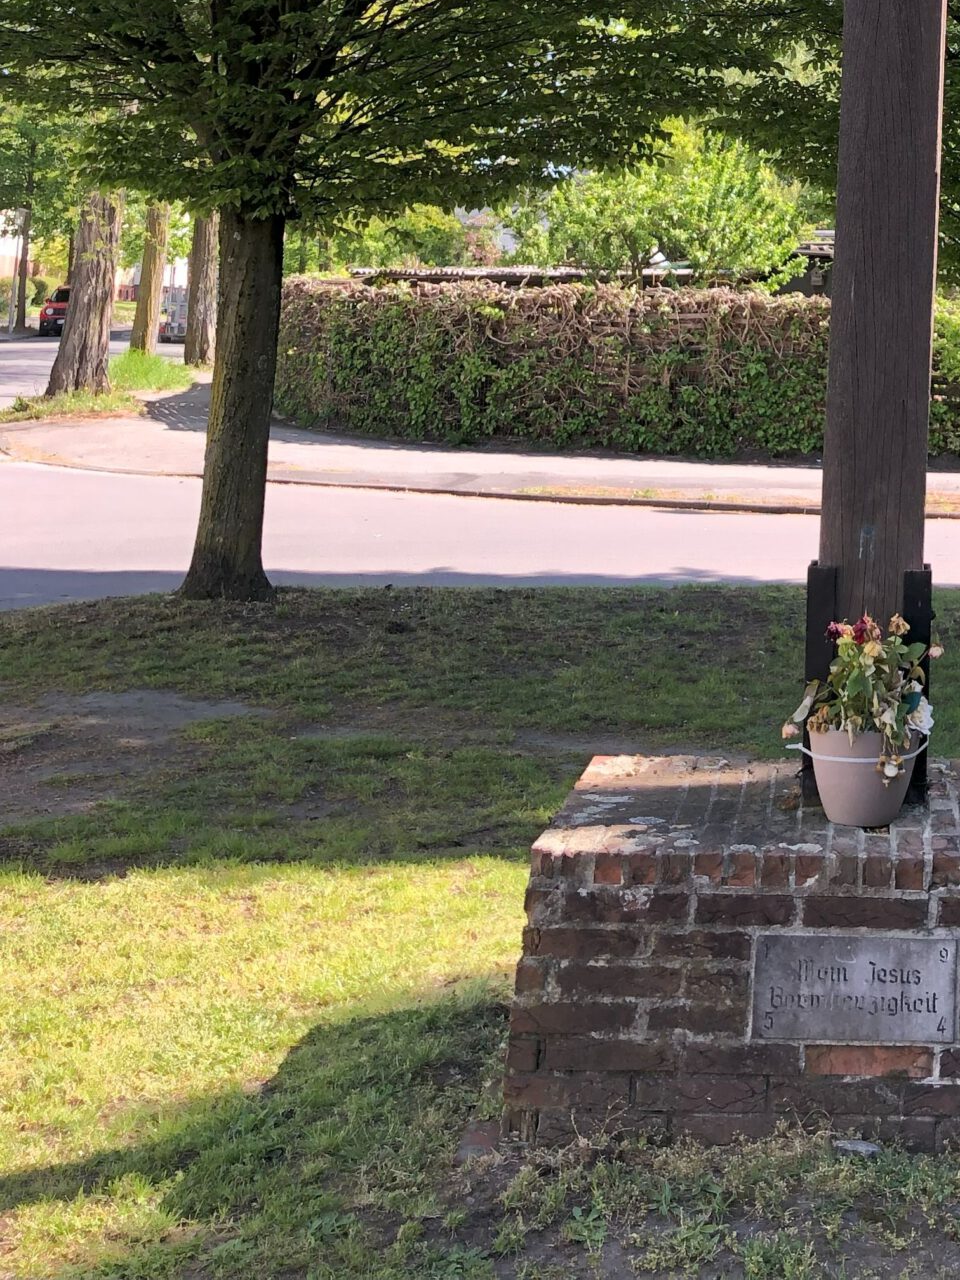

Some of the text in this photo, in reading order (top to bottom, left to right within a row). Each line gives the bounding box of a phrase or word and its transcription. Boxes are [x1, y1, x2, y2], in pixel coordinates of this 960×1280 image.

[939, 947, 949, 963] 9
[797, 959, 921, 985] Mein Jesus
[763, 1011, 946, 1034] 5 4
